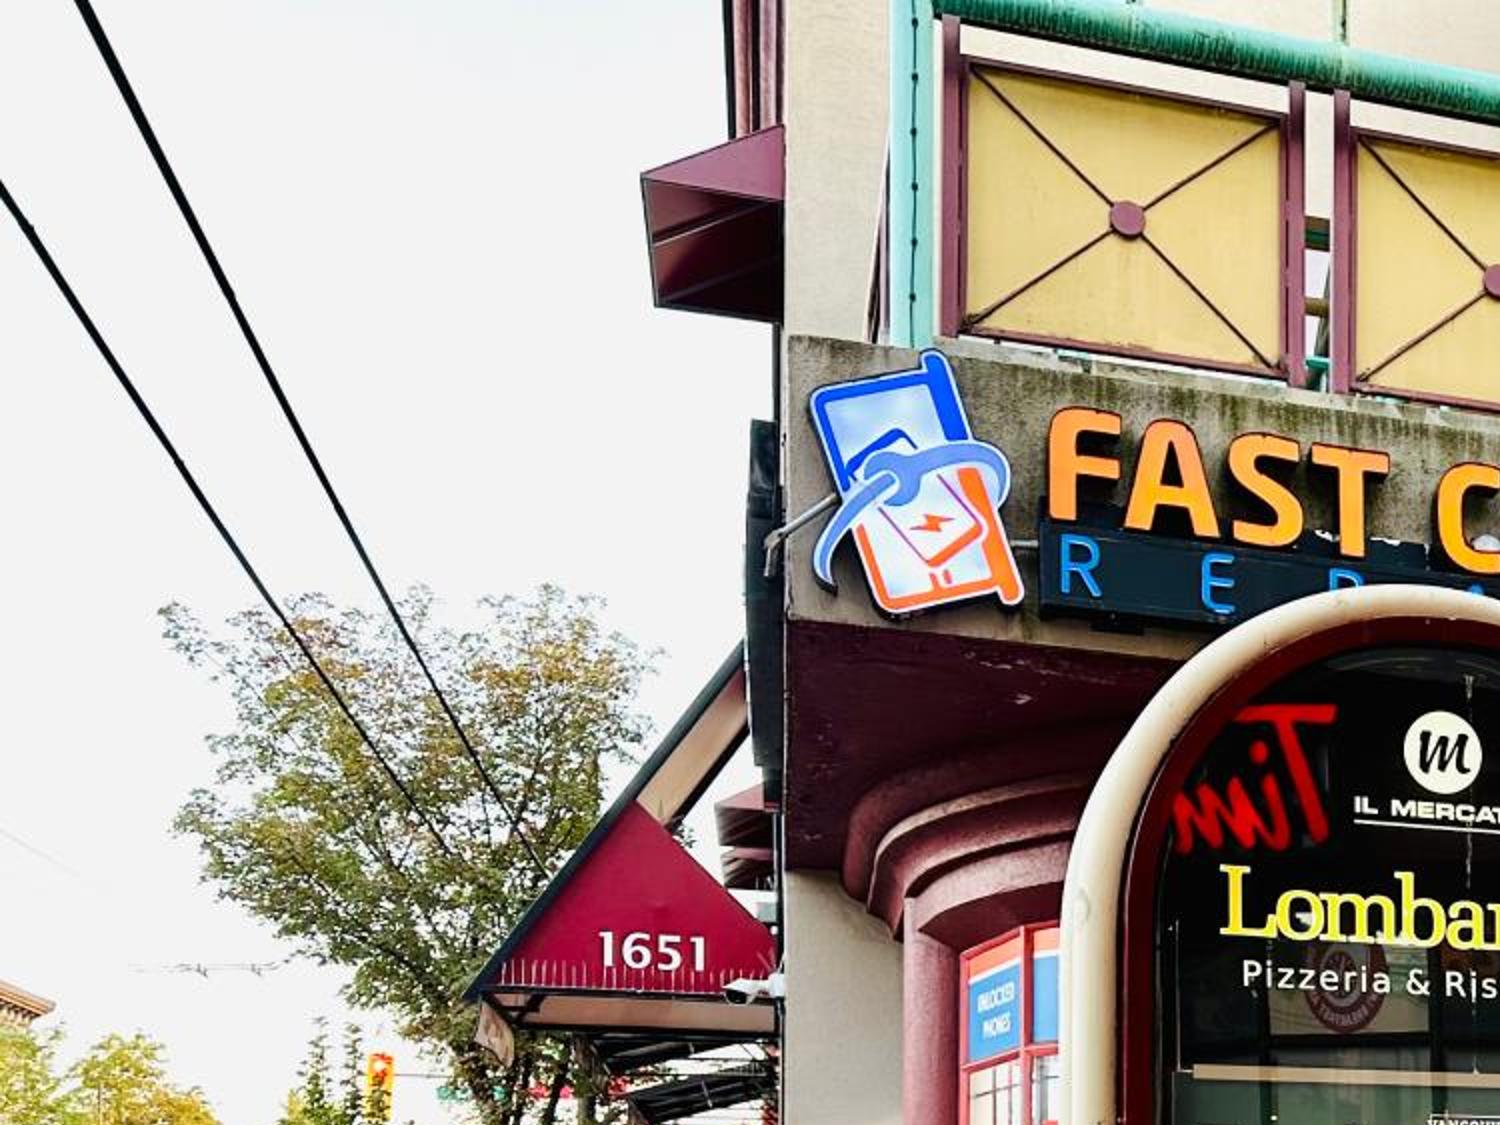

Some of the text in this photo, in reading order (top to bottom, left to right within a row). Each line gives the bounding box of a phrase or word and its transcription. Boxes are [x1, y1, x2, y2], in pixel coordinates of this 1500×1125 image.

[1049, 406, 1391, 558] FAST
[1354, 796, 1379, 816] IL
[599, 931, 706, 972] 1651
[1242, 960, 1391, 995] Pizzeria
[1406, 967, 1431, 995] &
